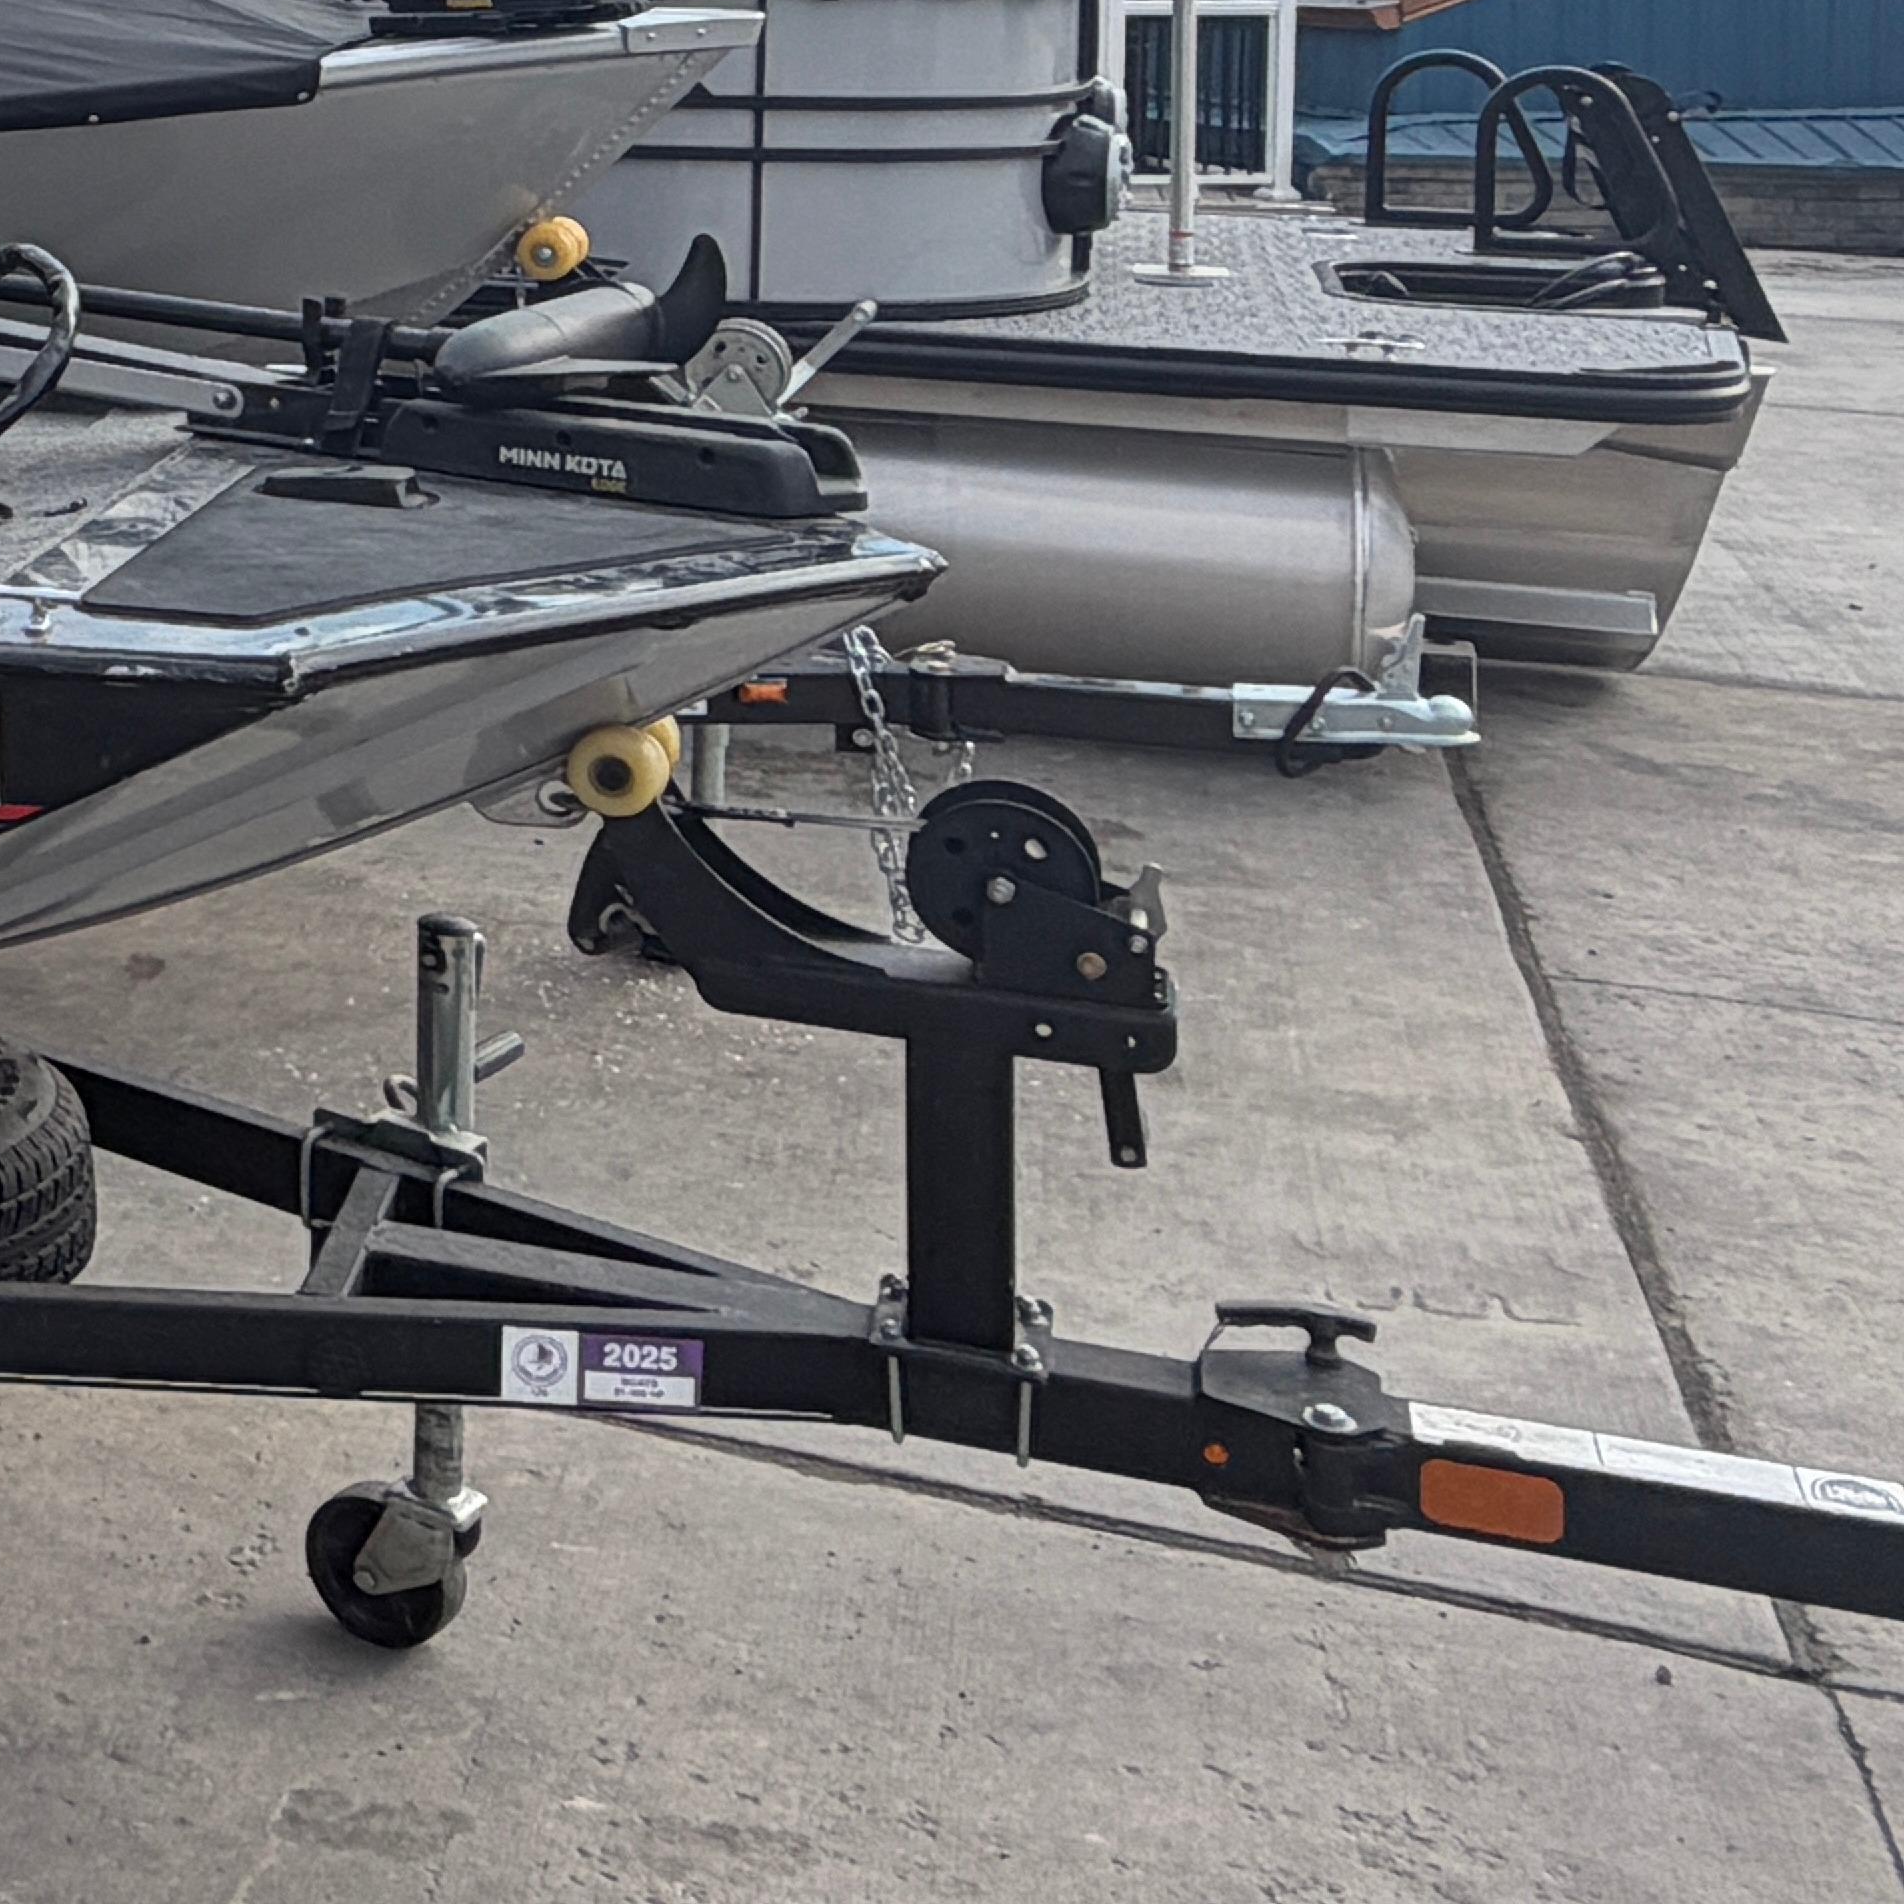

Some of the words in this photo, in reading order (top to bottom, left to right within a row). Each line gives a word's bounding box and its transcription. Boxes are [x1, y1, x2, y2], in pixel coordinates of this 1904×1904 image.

[498, 445, 560, 470] MINN
[565, 454, 626, 478] KOTA
[603, 1342, 678, 1372] 2025
